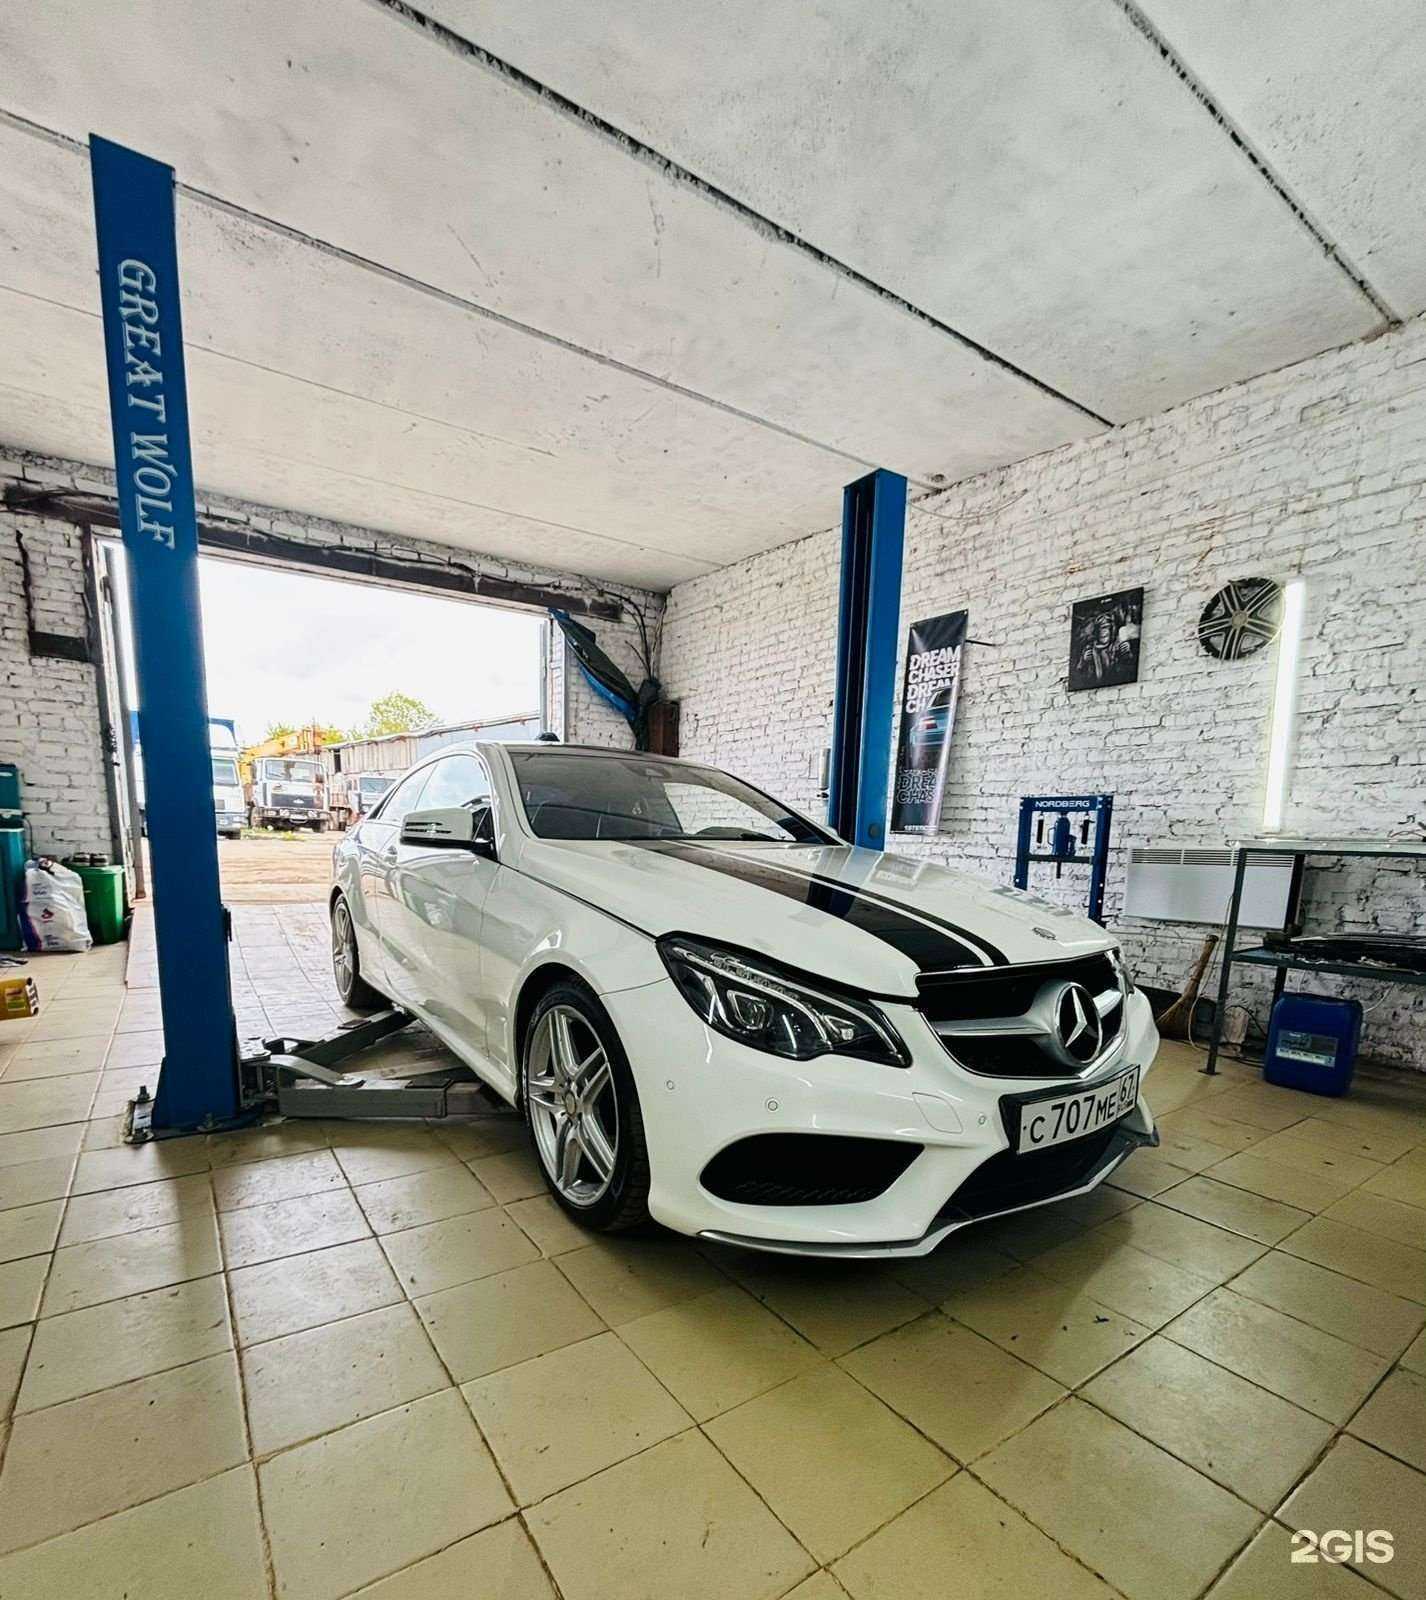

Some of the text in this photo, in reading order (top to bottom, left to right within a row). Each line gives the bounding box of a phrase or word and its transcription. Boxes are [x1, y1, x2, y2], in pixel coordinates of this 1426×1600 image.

[117, 258, 178, 549] GREAT WOLF
[909, 645, 961, 671] DREAM
[908, 661, 961, 684] CHASER
[1035, 800, 1090, 808] NORDBERG
[1120, 1073, 1134, 1102] 67
